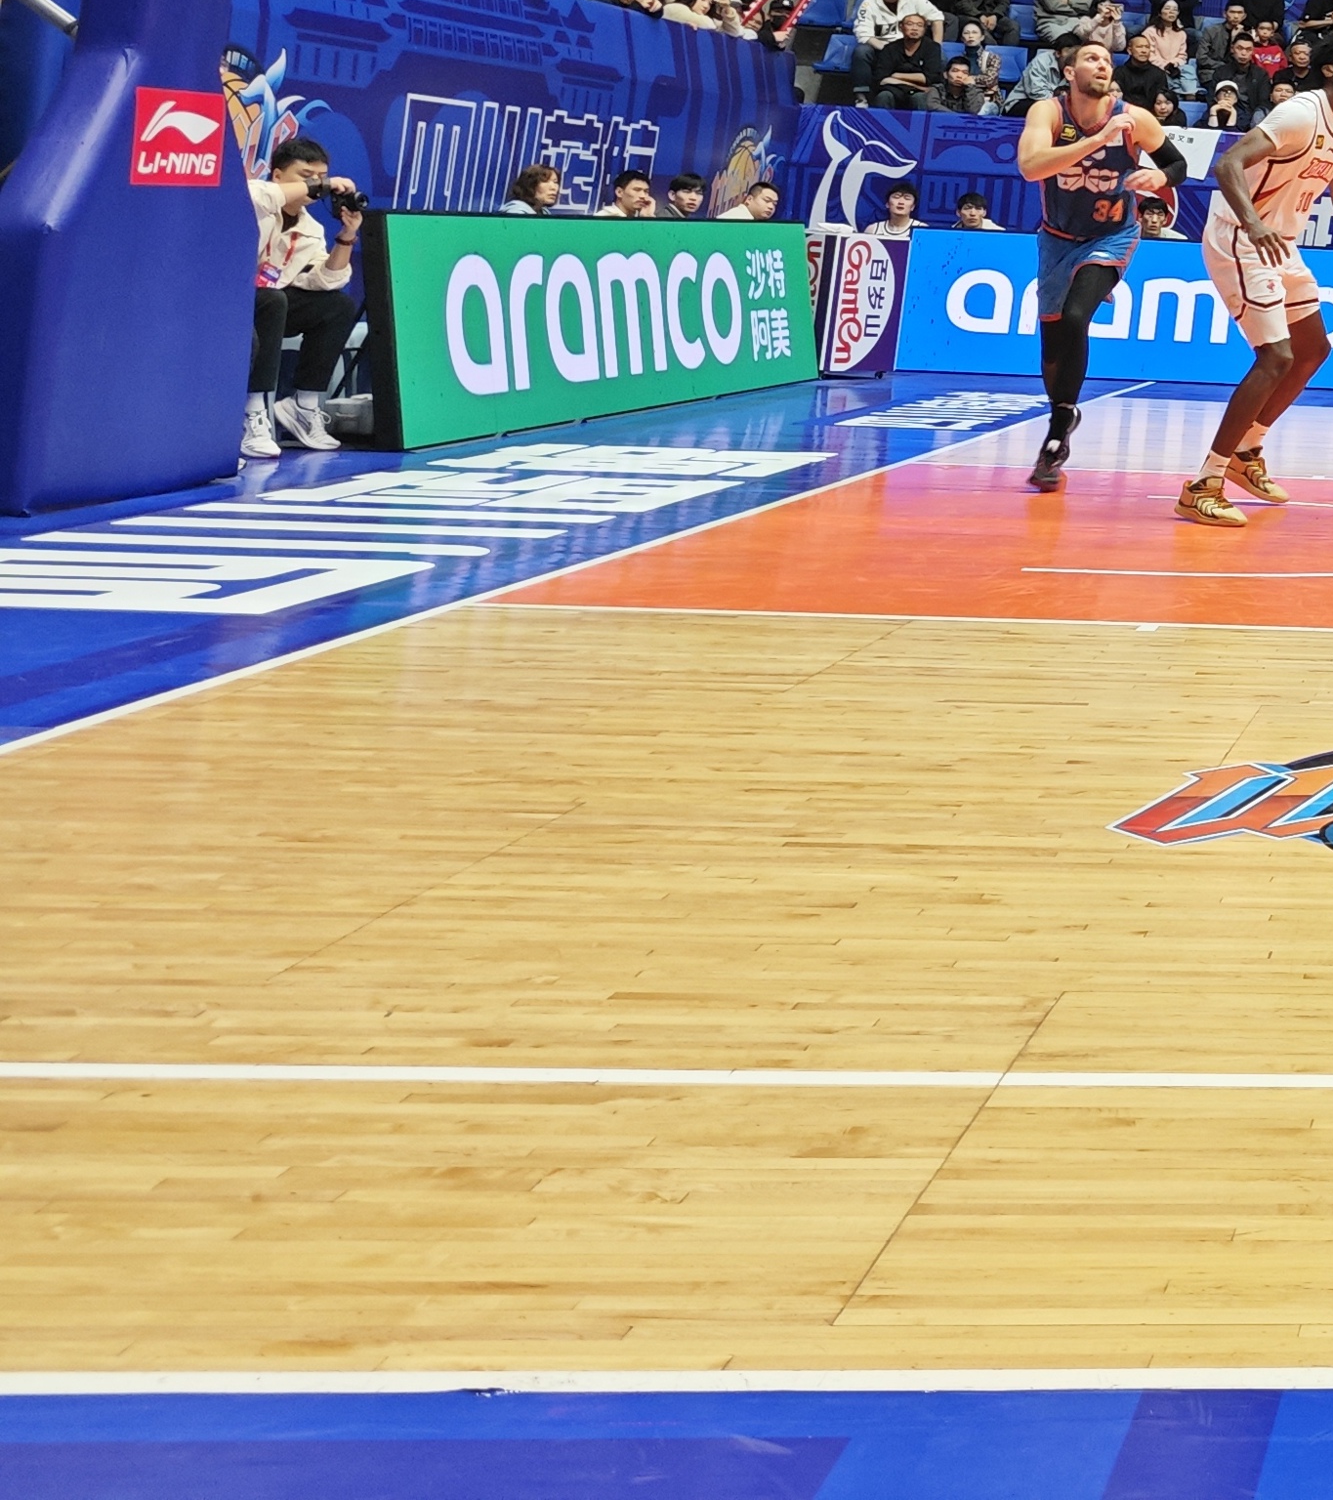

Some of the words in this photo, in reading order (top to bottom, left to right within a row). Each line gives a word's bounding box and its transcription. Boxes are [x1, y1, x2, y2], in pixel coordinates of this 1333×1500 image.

[137, 151, 217, 177] LI-NING
[1093, 198, 1124, 223] 34
[745, 248, 786, 301] 沙特
[863, 258, 889, 338] 百岁山
[445, 250, 743, 395] aramco
[751, 307, 791, 360] 阿美
